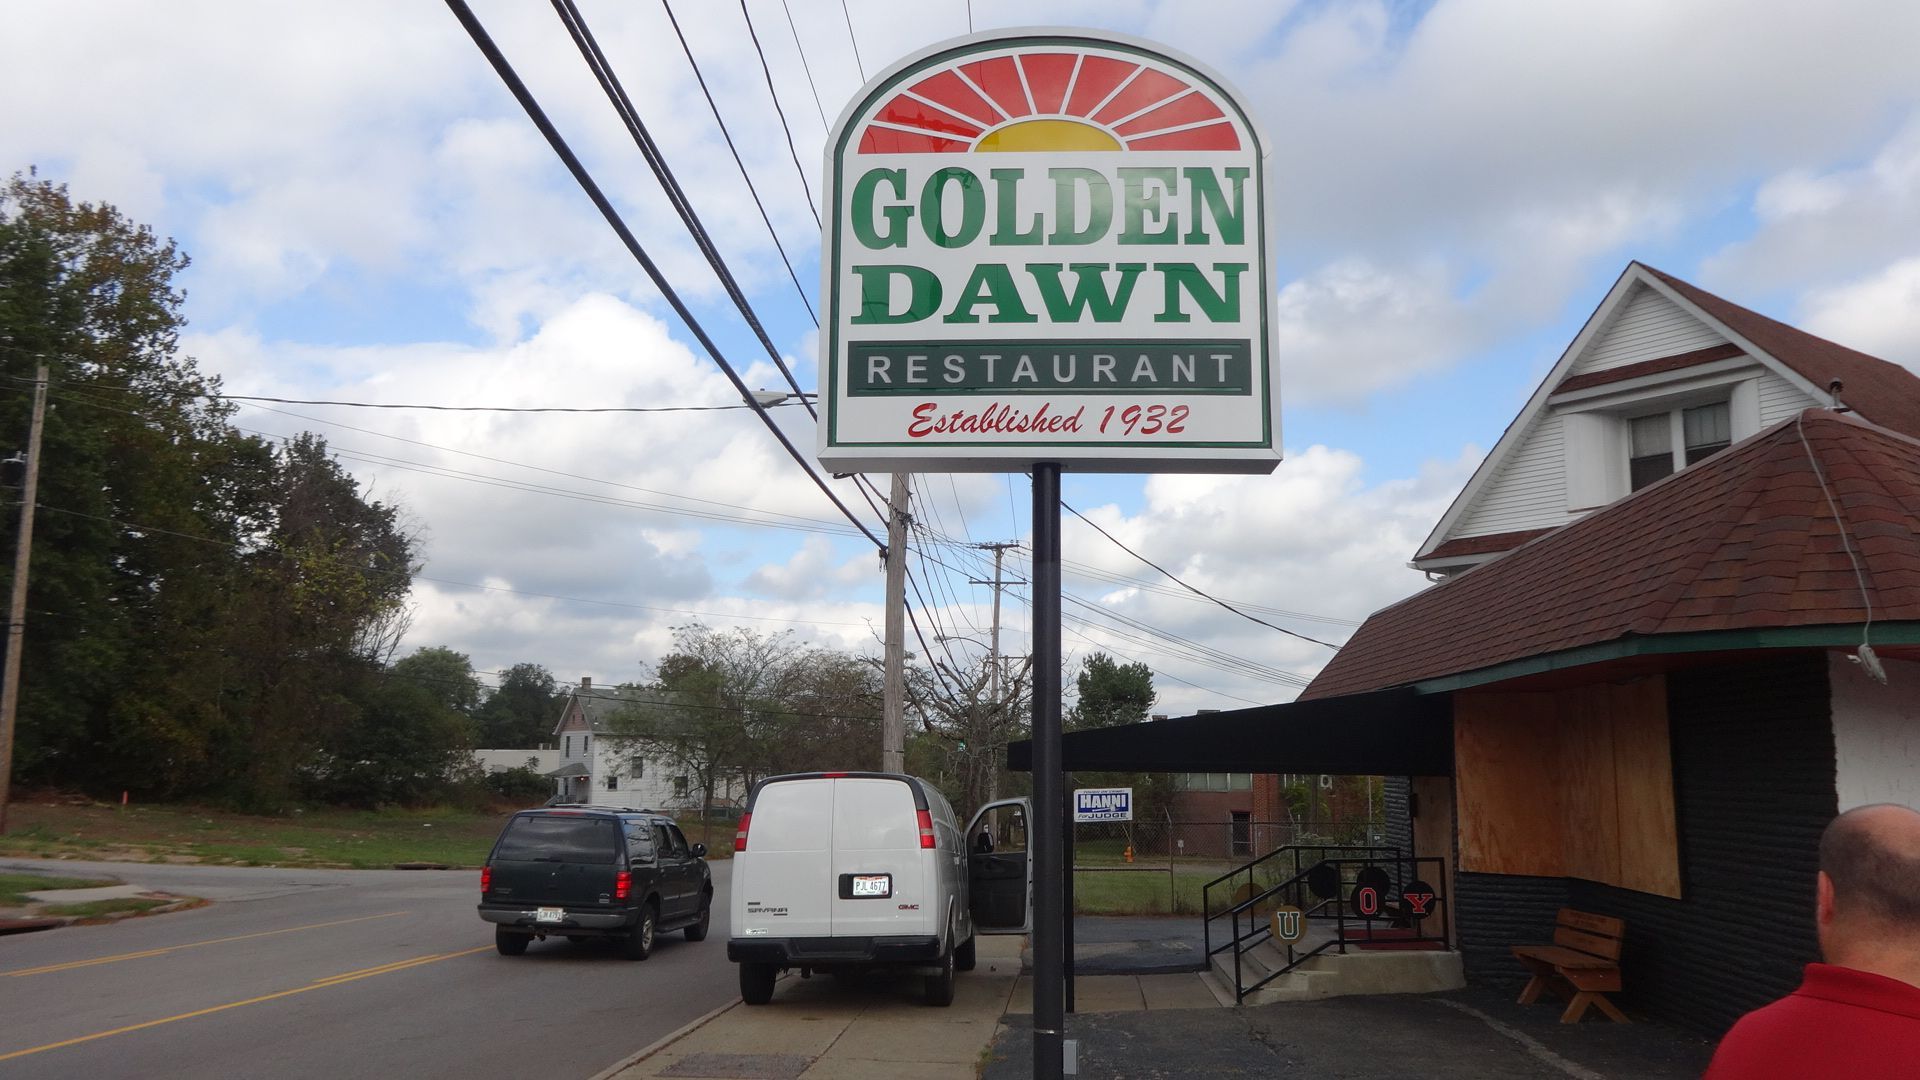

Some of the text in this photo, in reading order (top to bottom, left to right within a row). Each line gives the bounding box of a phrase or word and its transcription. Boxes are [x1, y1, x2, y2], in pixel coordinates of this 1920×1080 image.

[851, 167, 1250, 249] GOLDEN
[850, 262, 1249, 325] DAWN
[867, 353, 1233, 384] RESTAURANT
[907, 402, 1191, 438] Established 1932
[1080, 794, 1126, 808] HANNI
[855, 881, 886, 891] PJL 4677
[1403, 893, 1433, 913] Y
[1277, 911, 1300, 940] U
